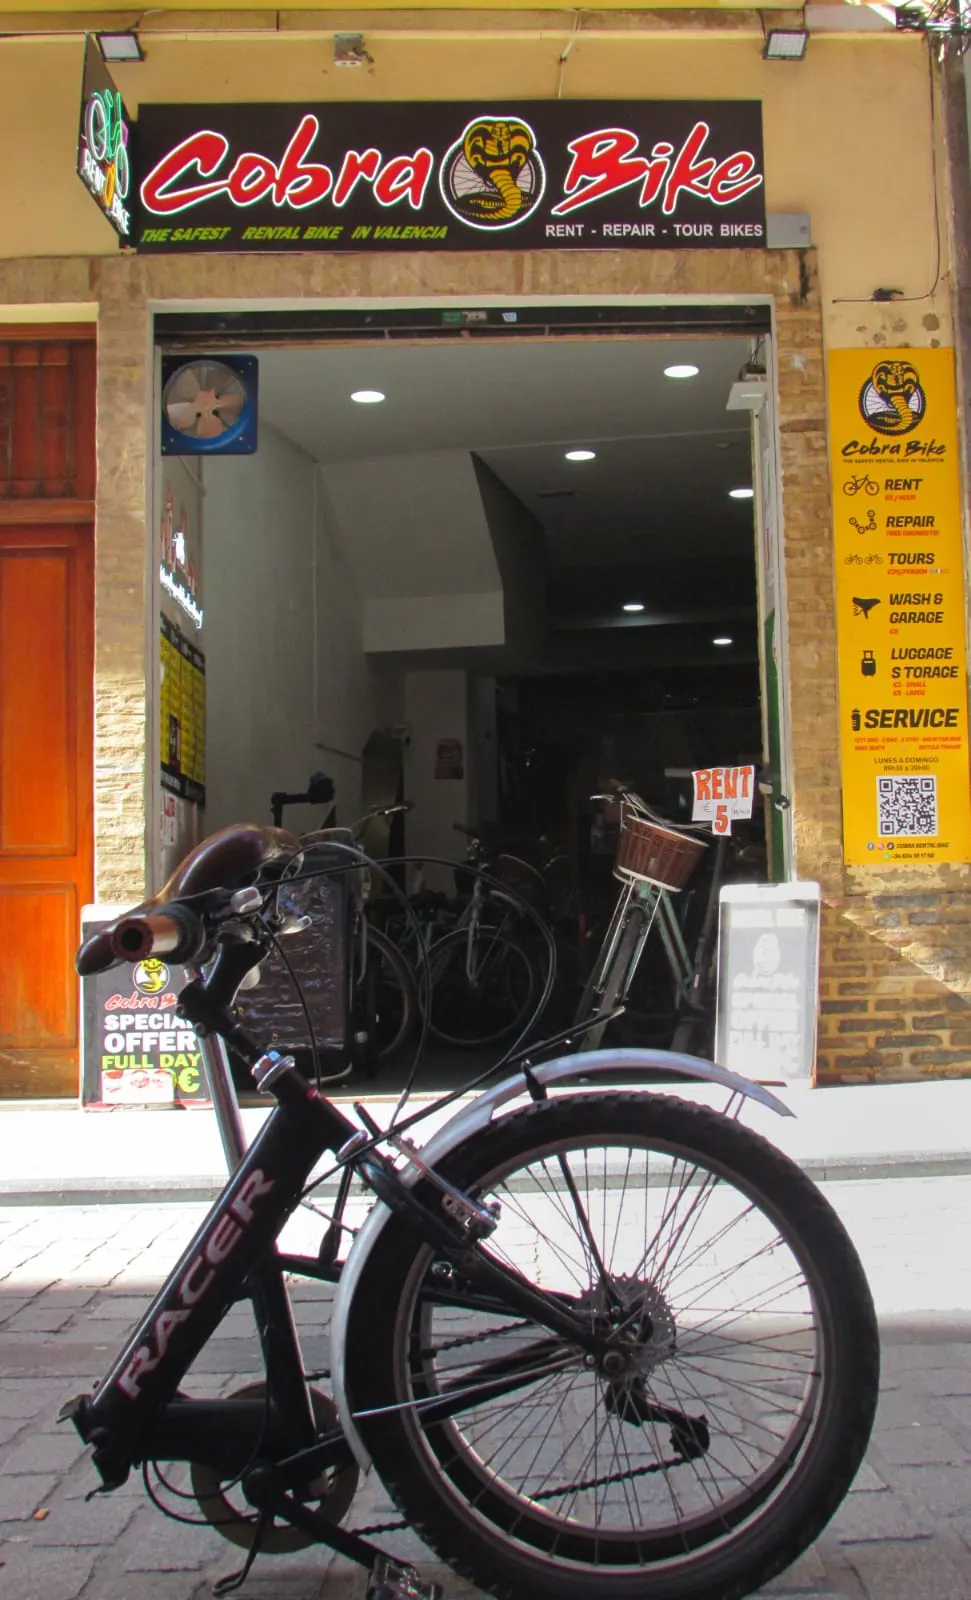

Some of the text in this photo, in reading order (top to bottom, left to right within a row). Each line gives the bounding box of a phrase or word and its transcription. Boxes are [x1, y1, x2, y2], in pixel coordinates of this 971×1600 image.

[140, 114, 763, 216] Cobra Bike
[140, 225, 448, 243] THE SAFEST RENTAL BIKE IN VALENCIA
[545, 224, 584, 237] RENT
[603, 224, 655, 237] REPAIR
[673, 224, 713, 237] TOUR
[720, 224, 763, 237] BIKES
[842, 437, 946, 457] Cobra Bike
[884, 479, 923, 491] RENT
[886, 516, 935, 528] REPAIR
[888, 553, 935, 565] TOURS
[889, 593, 943, 606] WASH &
[889, 611, 944, 624] GARAGE
[891, 648, 953, 660] LUGGAGE
[864, 708, 960, 729] SERVICE
[695, 767, 752, 801] RENT
[714, 805, 728, 833] 5
[104, 991, 159, 1011] Cobra
[104, 1013, 194, 1031] SPECIA
[104, 1031, 197, 1053] OFFER
[102, 1053, 201, 1069] FULL DAY
[117, 1169, 275, 1400] RACER
